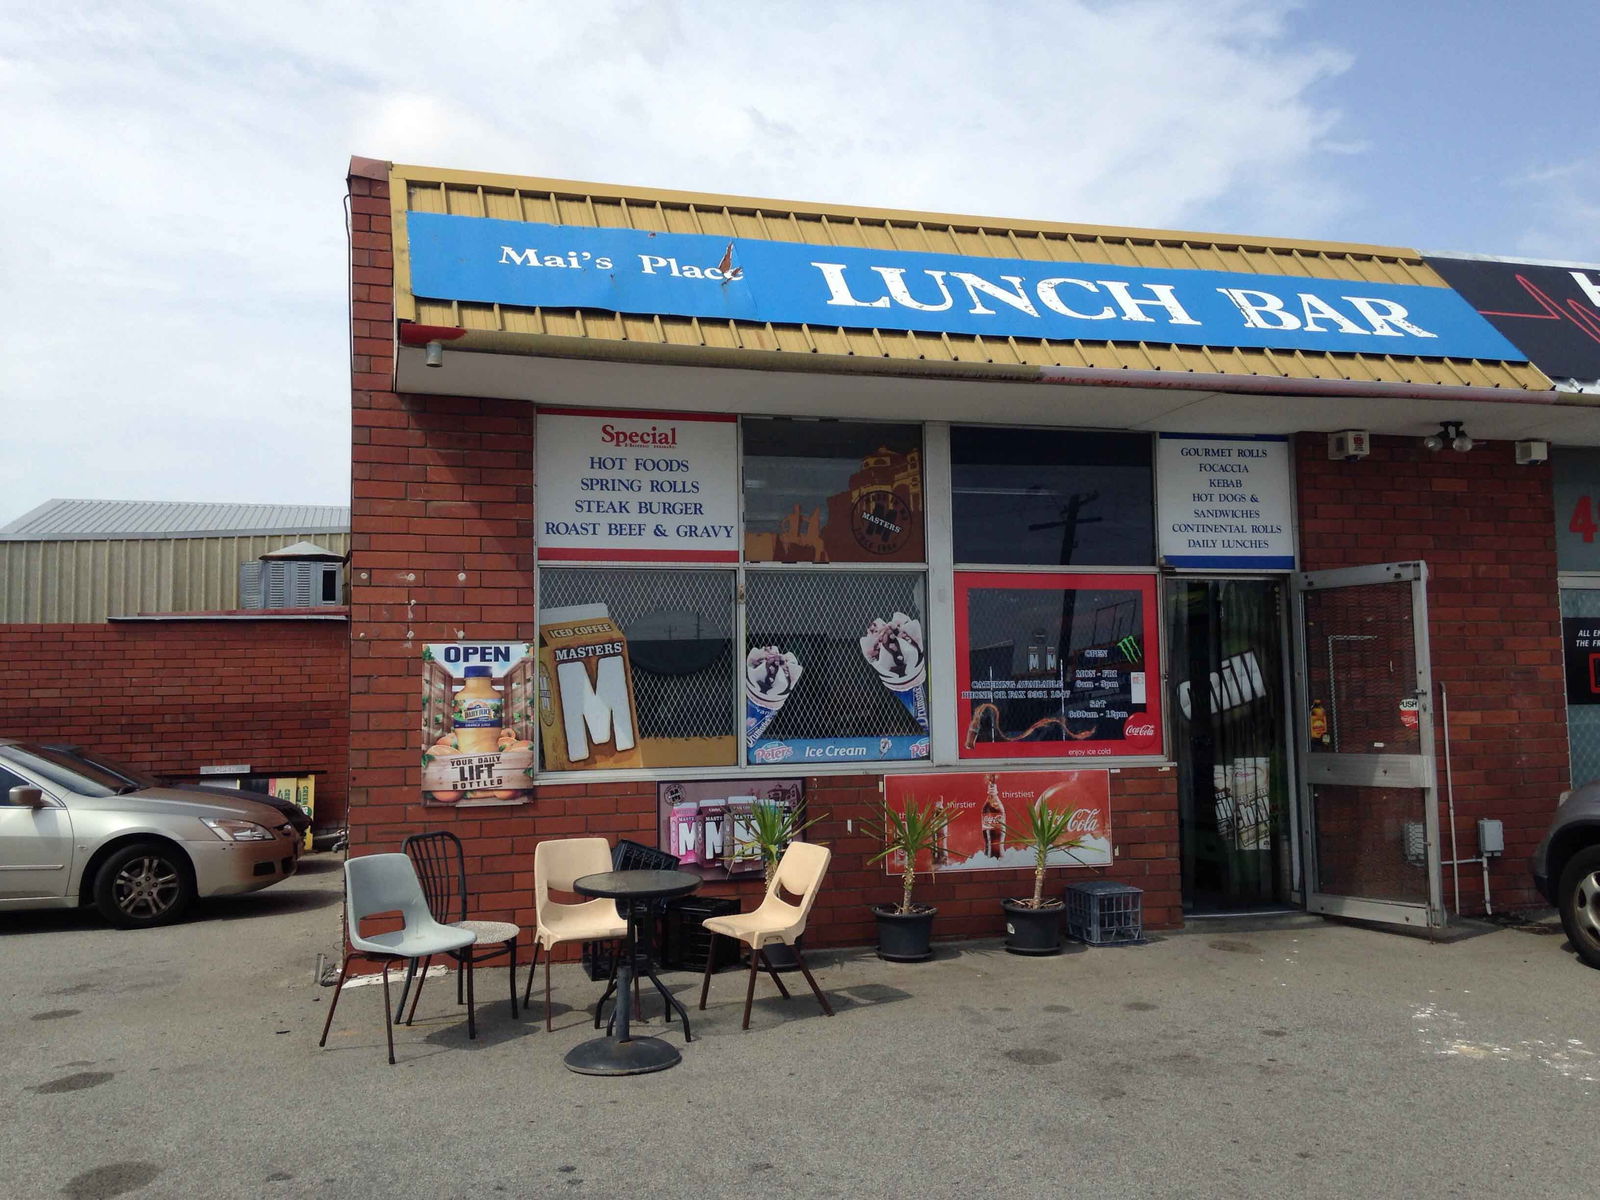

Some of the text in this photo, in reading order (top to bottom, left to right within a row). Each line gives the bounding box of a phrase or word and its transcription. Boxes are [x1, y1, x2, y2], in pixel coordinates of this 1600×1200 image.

[499, 246, 744, 281] Mai's Place
[811, 262, 1438, 338] LUNCH BAR
[601, 424, 678, 447] Special
[1180, 447, 1268, 458] GOURMET ROLLS
[589, 456, 690, 473] HOT FOODS
[1199, 463, 1249, 473] FOCACCIA
[580, 478, 700, 494] SPRING ROLLS
[1209, 479, 1243, 488] KEBAB
[1192, 493, 1259, 503] HOT DOGS &
[574, 500, 704, 516] STEAK BURGER
[1193, 509, 1260, 519] SANDWICHES
[1569, 495, 1600, 543] 4
[861, 511, 902, 534] MASTERS
[545, 522, 734, 539] ROAST BEEF & GRAVY
[1171, 523, 1282, 534] CONTINENTAL ROLLS
[1187, 539, 1270, 549] DAILY LUNCHES
[550, 622, 612, 639] ICED COFFEE
[1578, 629, 1591, 637] ALL
[1575, 639, 1589, 647] THE
[444, 646, 510, 663] OPEN
[555, 641, 625, 662] MASTERS
[1084, 649, 1108, 658] OPEN
[1075, 669, 1096, 678] MON
[1102, 669, 1118, 678] FRI
[1016, 680, 1064, 689] AVAILABLE
[961, 690, 993, 700] PHONE
[993, 690, 1007, 699] OR
[1007, 690, 1026, 699] FAX
[1089, 700, 1107, 708] SAT
[805, 746, 823, 757] Ice
[825, 745, 867, 757] Cream
[1068, 749, 1086, 757] enjoy
[450, 755, 501, 767] YOUR DAILY
[459, 763, 496, 782] LIFT
[452, 778, 503, 790] BOTTLED
[1002, 790, 1035, 798] thirstiest
[947, 801, 977, 809] thirstier
